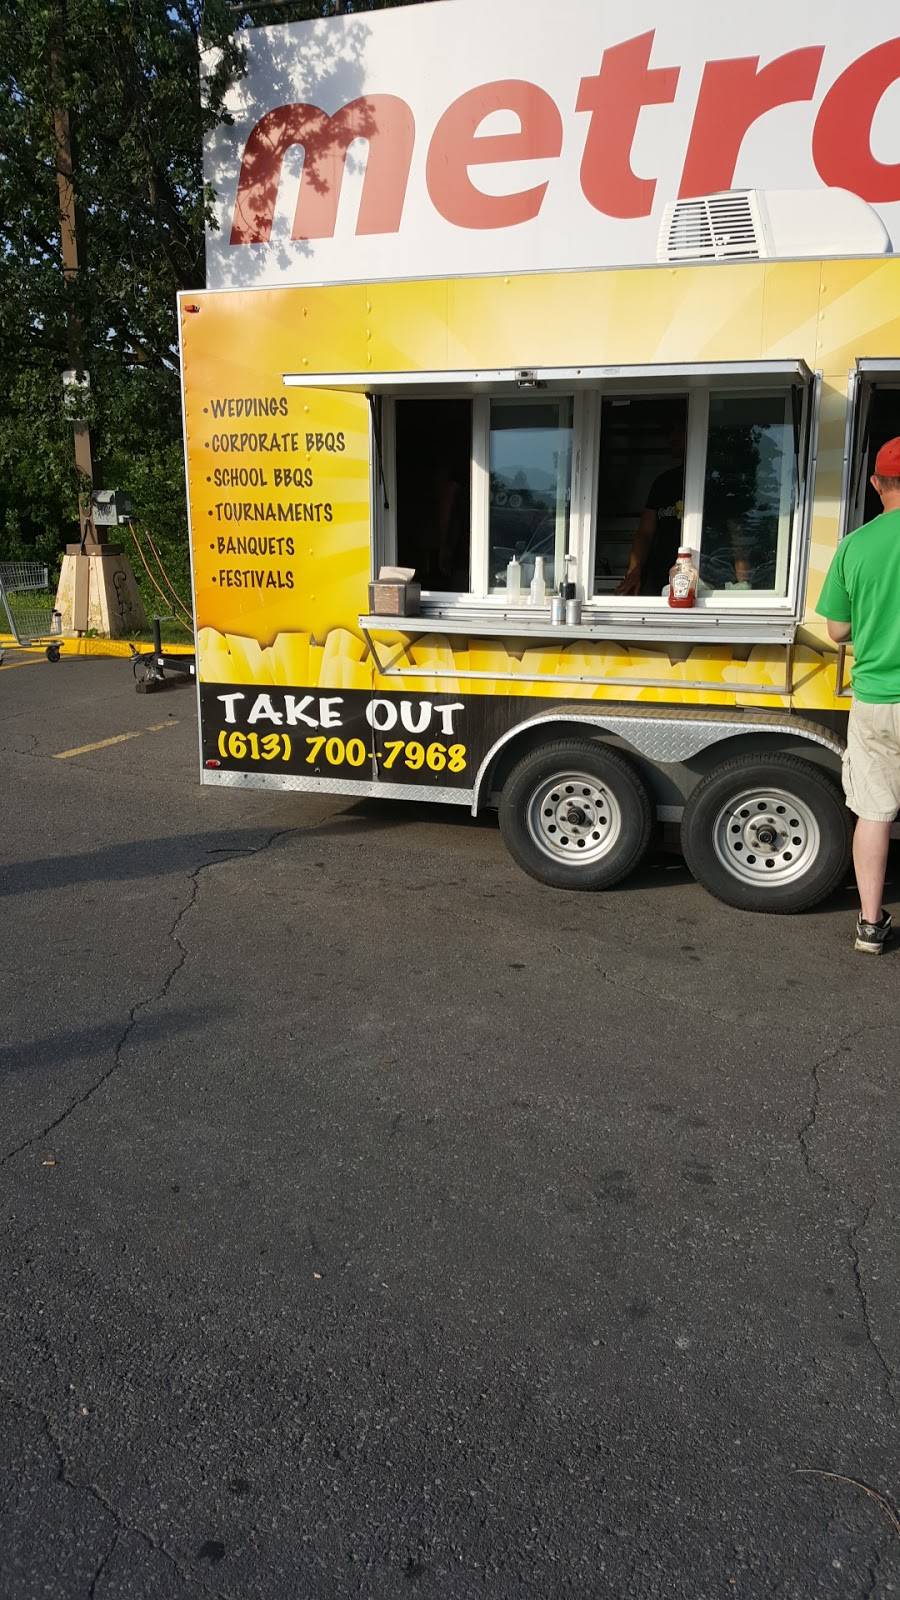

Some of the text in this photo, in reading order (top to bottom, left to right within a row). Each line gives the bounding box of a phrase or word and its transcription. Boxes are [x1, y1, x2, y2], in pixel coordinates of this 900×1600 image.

[210, 397, 288, 418] WEDDINGS
[212, 432, 346, 453] CORPORATE BBQS
[213, 468, 313, 488] SCHOOL BBQS
[215, 502, 333, 522] TOURNAMENTS
[217, 536, 295, 556] BANQUETS
[219, 569, 295, 589] FESTIVALS
[216, 692, 465, 736] TAKE OUT
[217, 730, 467, 773] (613) 700-7968
